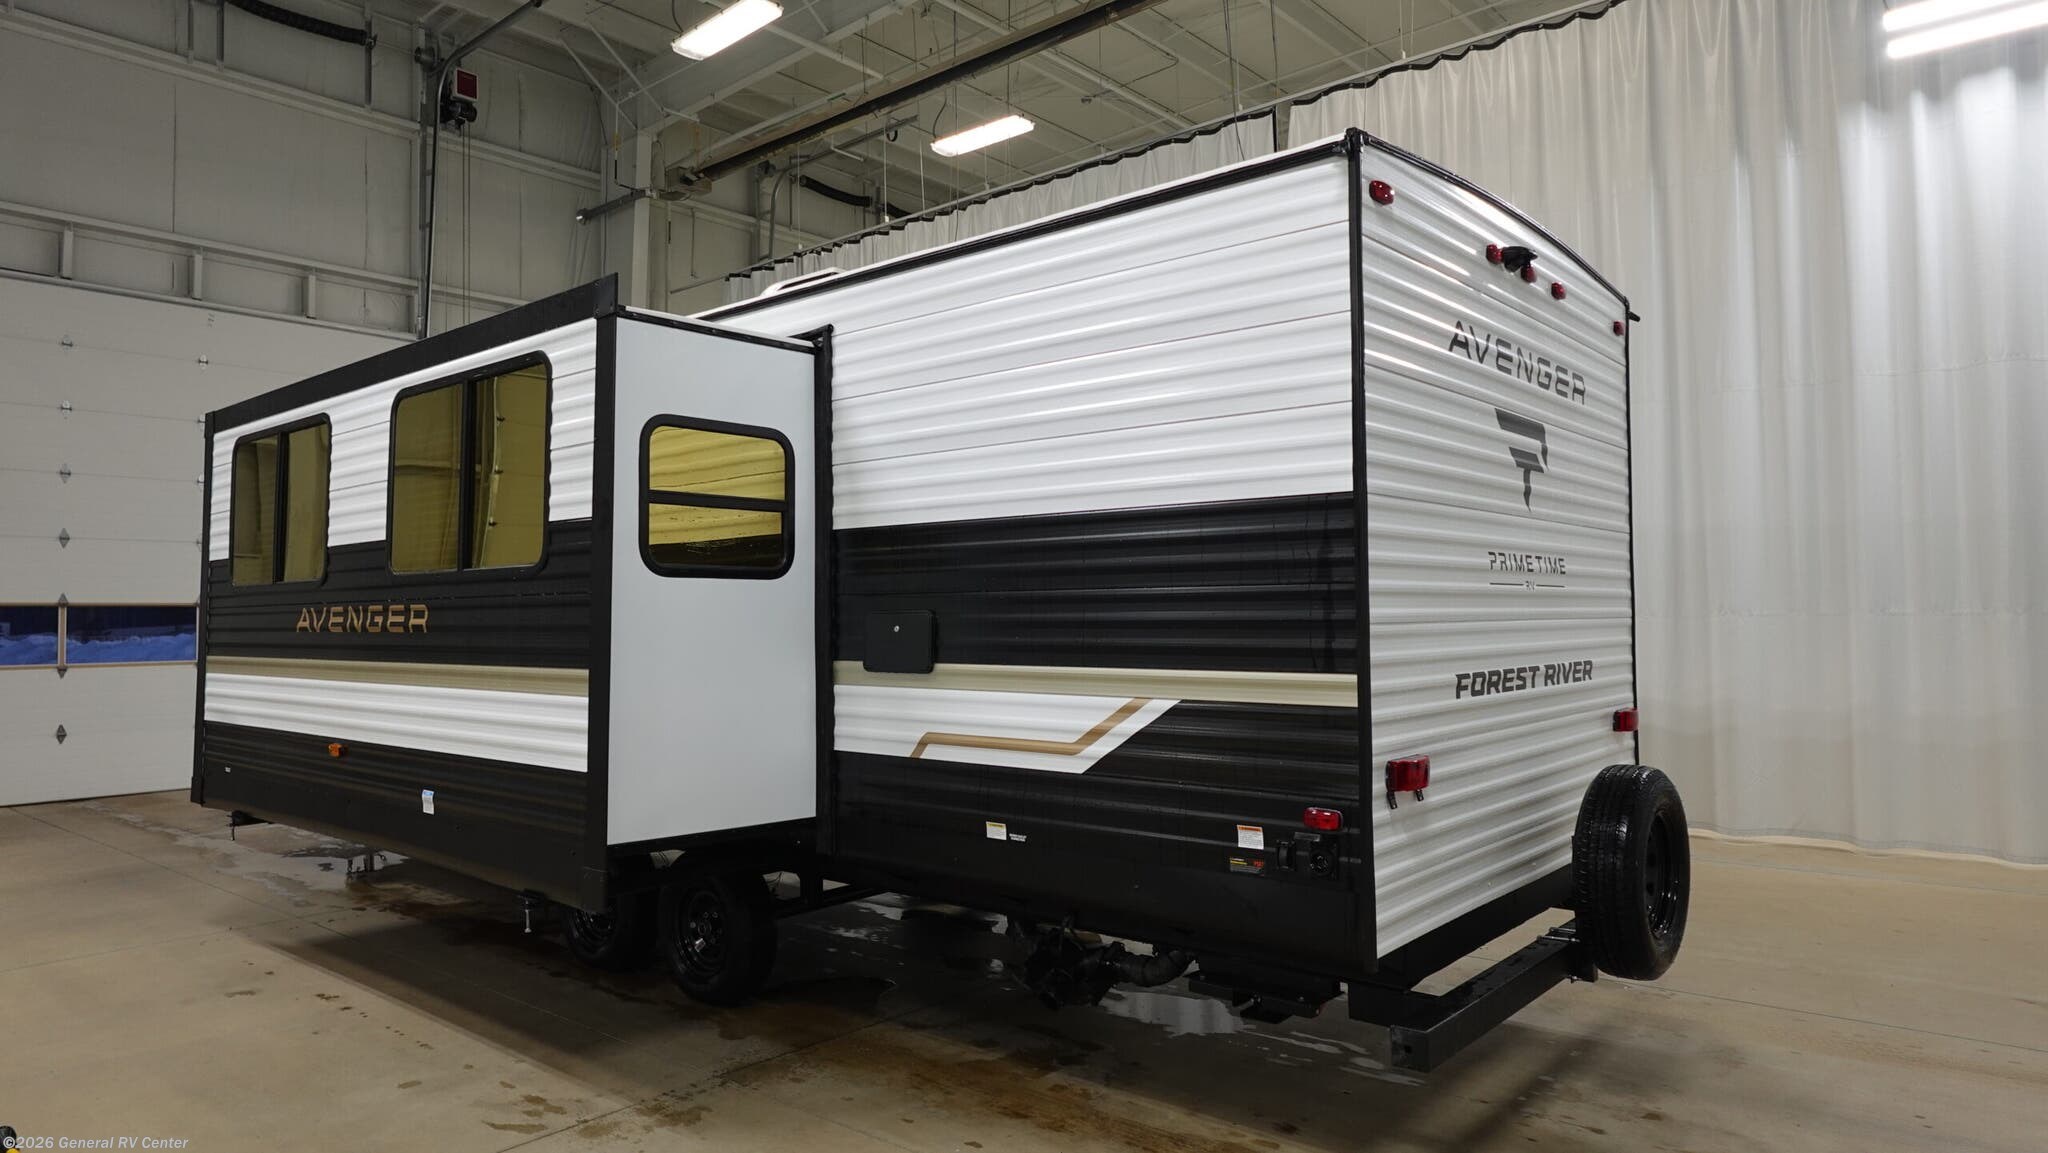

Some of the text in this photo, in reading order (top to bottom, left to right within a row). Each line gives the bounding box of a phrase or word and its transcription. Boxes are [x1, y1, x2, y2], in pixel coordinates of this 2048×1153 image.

[1449, 320, 1586, 405] AVENGER
[1487, 551, 1566, 575] PRIMETIME
[296, 603, 429, 633] AVENGER
[1455, 660, 1593, 700] FOREST RIVER
